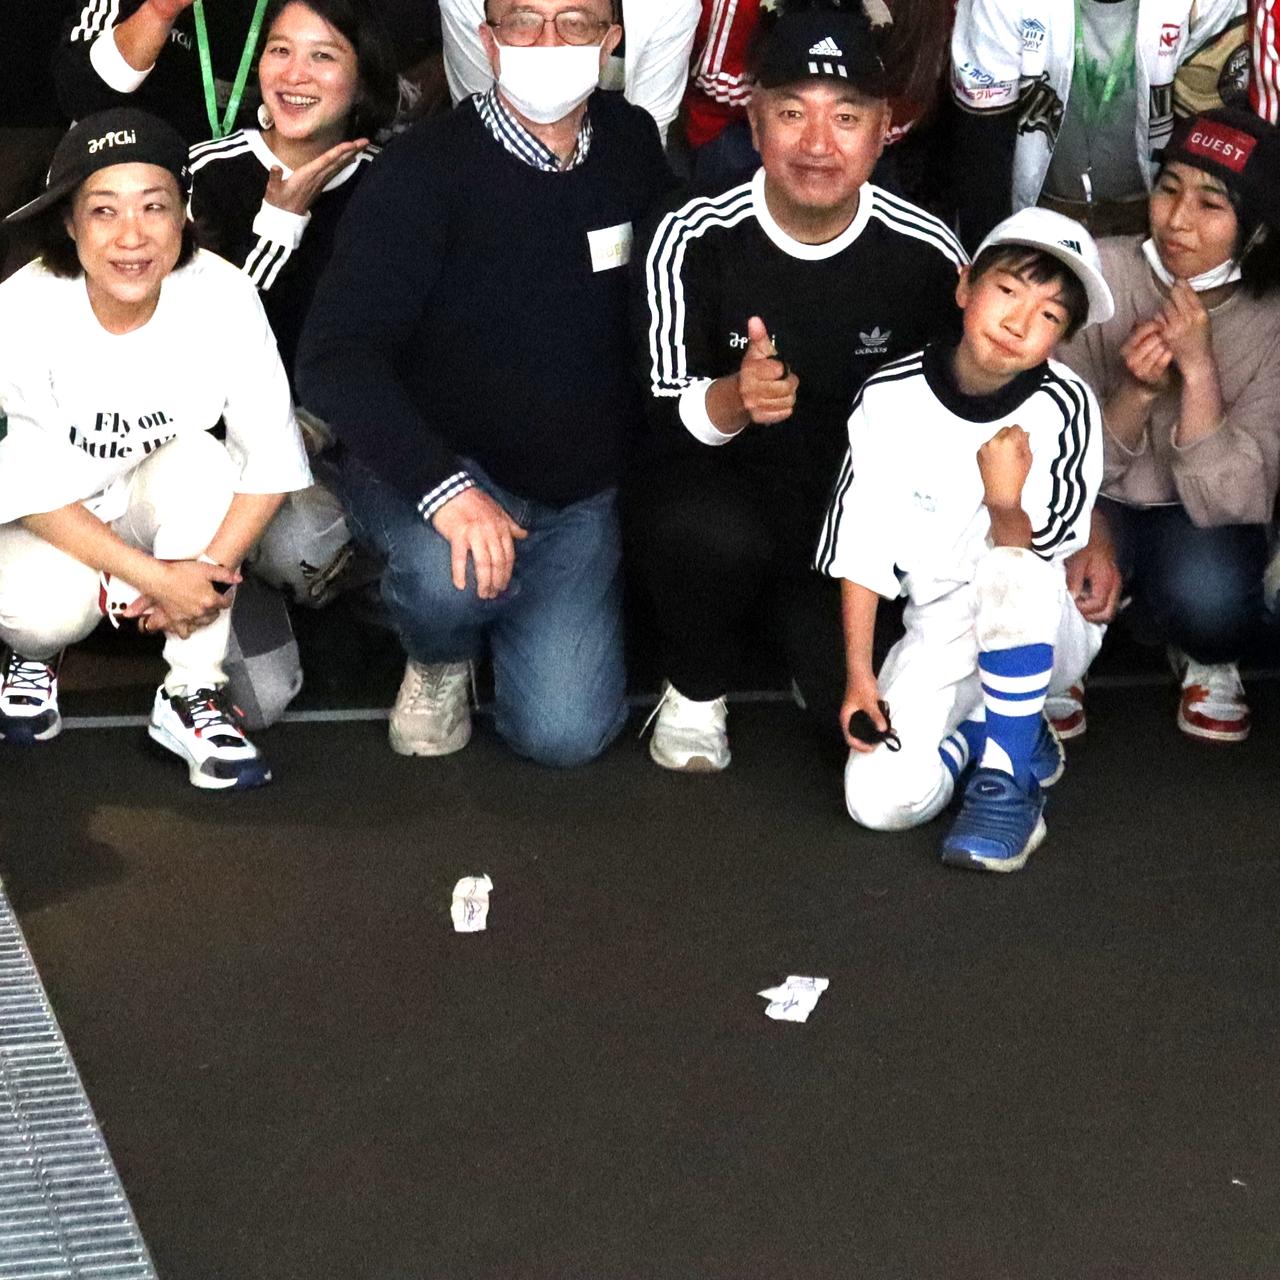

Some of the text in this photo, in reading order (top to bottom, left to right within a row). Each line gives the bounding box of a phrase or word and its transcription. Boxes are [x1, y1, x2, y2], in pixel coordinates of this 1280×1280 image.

[808, 47, 843, 57] adidas
[1190, 131, 1246, 161] GUEST
[94, 412, 131, 439] Fly
